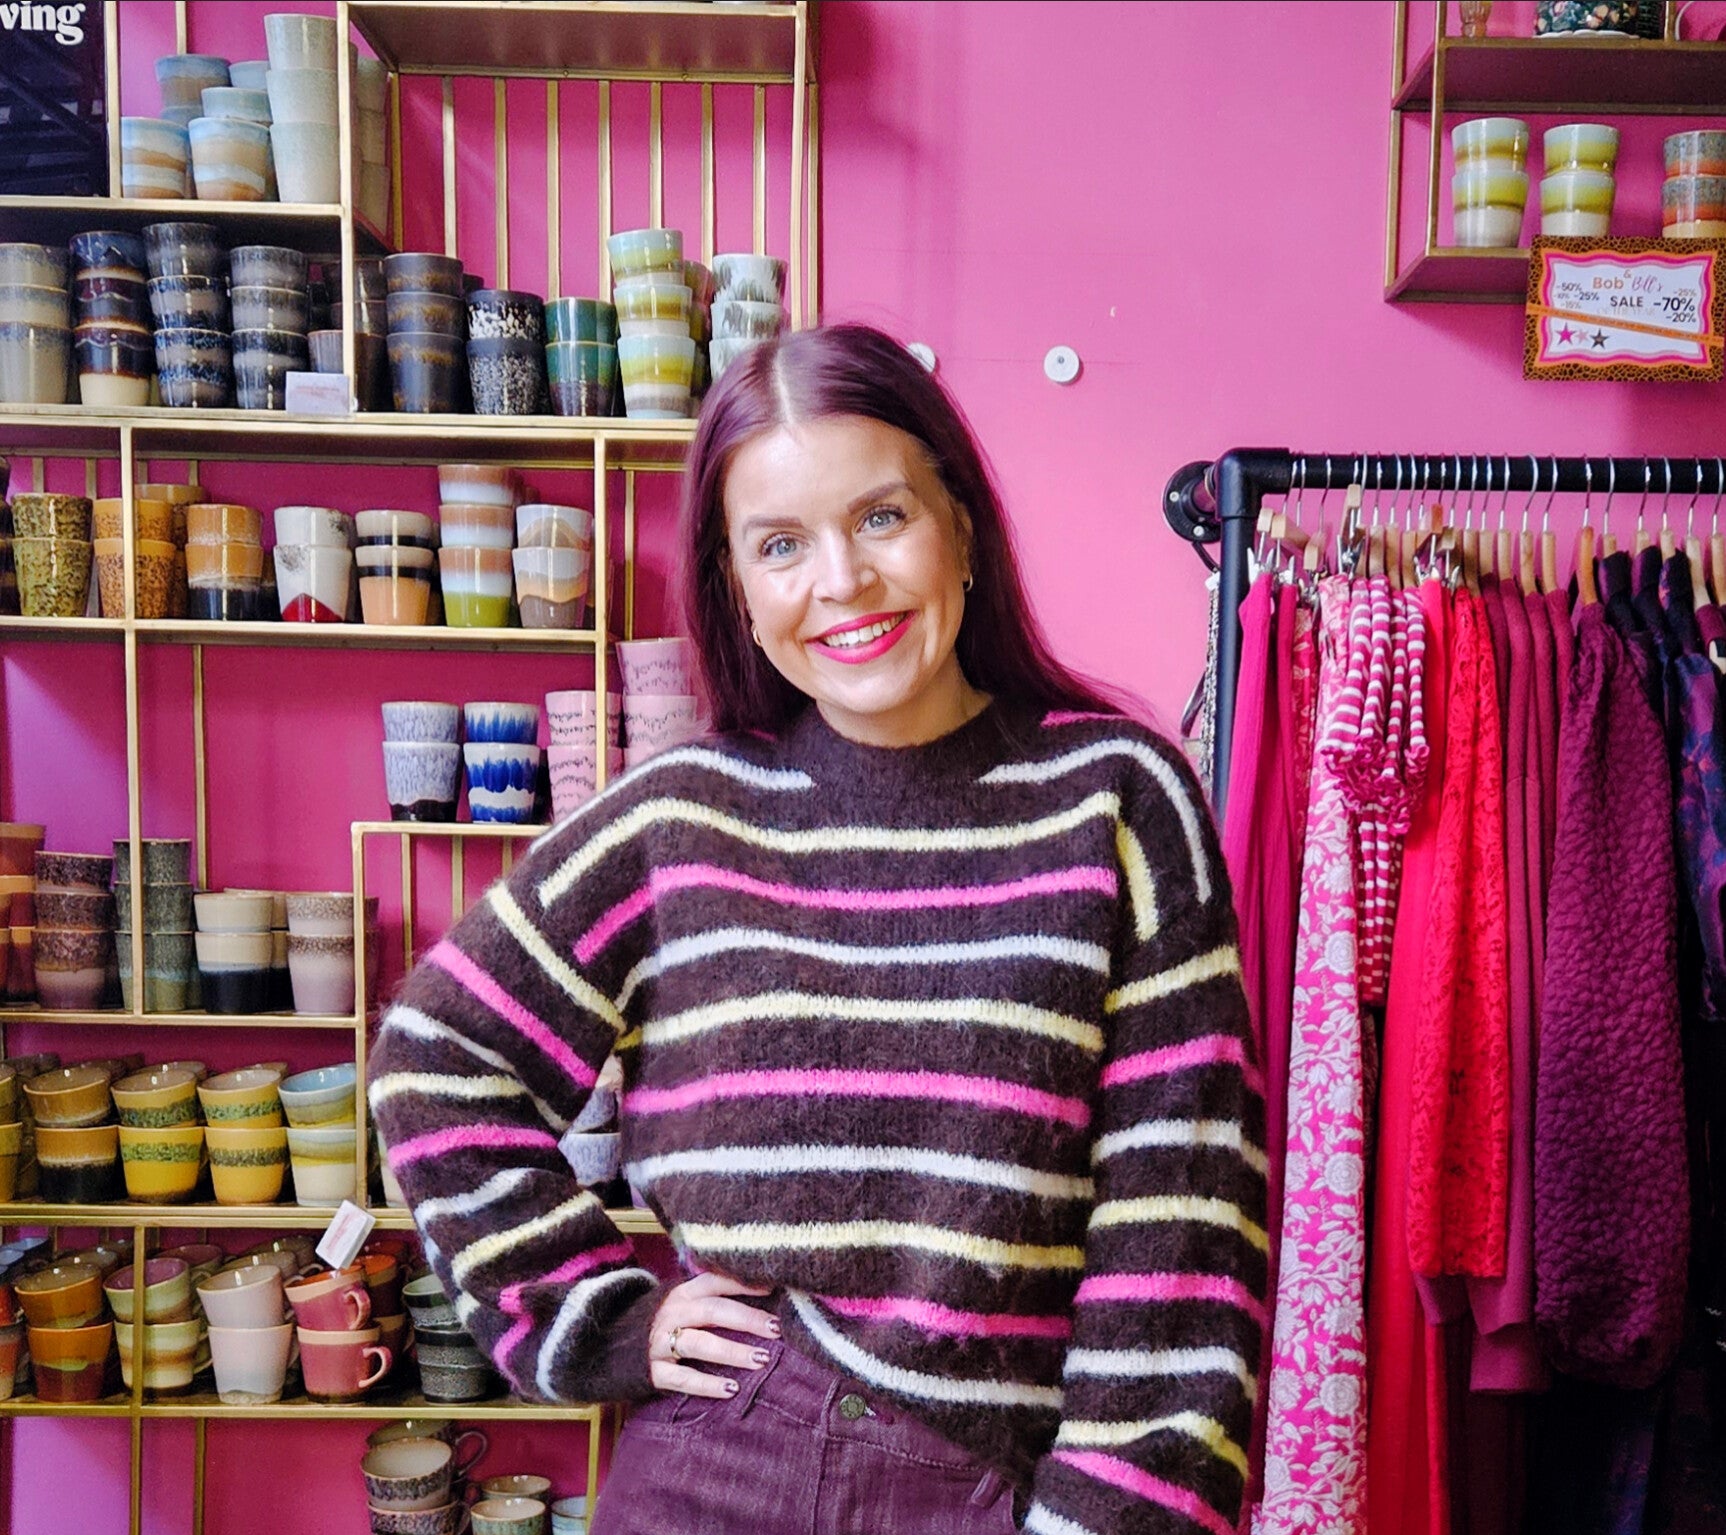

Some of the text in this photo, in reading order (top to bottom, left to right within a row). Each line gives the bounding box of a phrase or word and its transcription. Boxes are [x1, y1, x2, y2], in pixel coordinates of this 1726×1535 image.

[0, 1, 86, 45] ving
[1593, 277, 1624, 289] Bob
[1623, 269, 1632, 278] &
[1556, 282, 1582, 292] -50%
[1574, 291, 1600, 301] -25%
[1610, 296, 1644, 307] SALE
[1653, 297, 1695, 311] -70%
[1666, 312, 1697, 323] -20%
